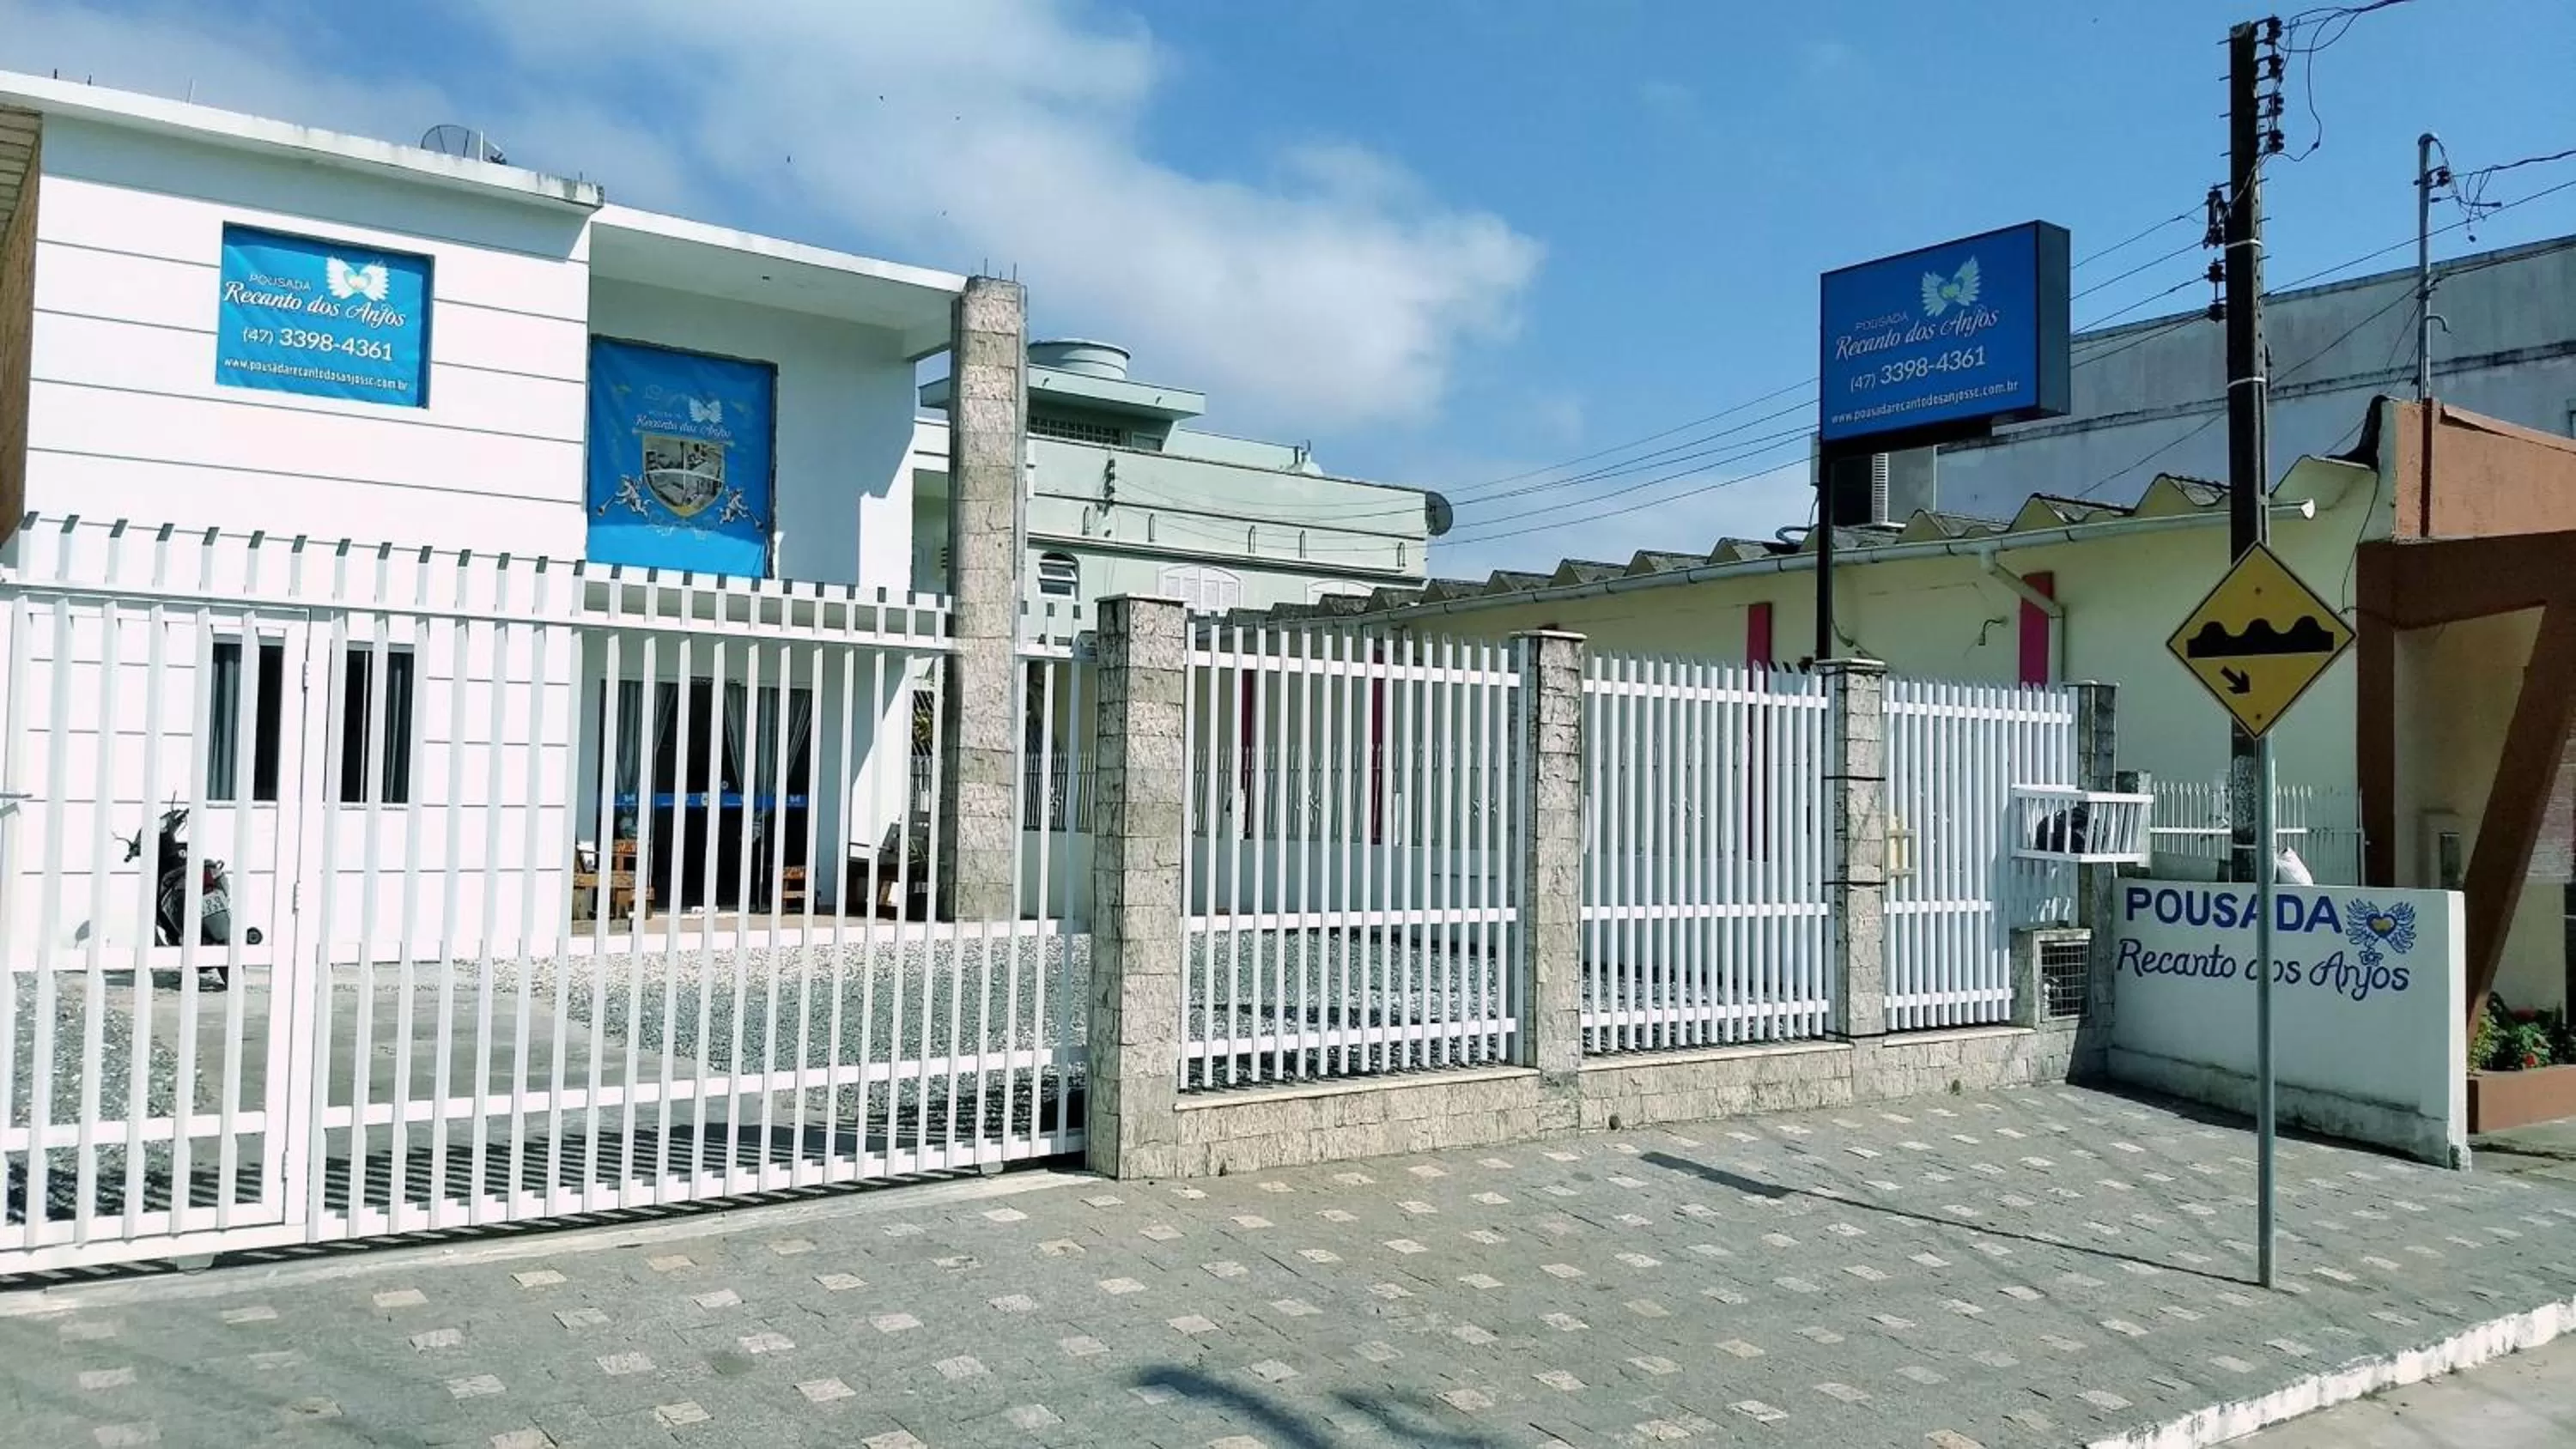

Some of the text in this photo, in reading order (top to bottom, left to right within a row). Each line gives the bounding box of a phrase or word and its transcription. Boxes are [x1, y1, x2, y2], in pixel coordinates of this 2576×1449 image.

[223, 281, 406, 329] Recanto dos Anjos
[248, 274, 312, 292] POUSADA
[242, 328, 392, 362] (47) 3398-4361
[1835, 305, 2000, 361] Recanto dos Anjos
[1850, 345, 1986, 394] (47) 3398-4361
[2117, 937, 2236, 978] Recanto
[2310, 949, 2410, 1002] Anjos
